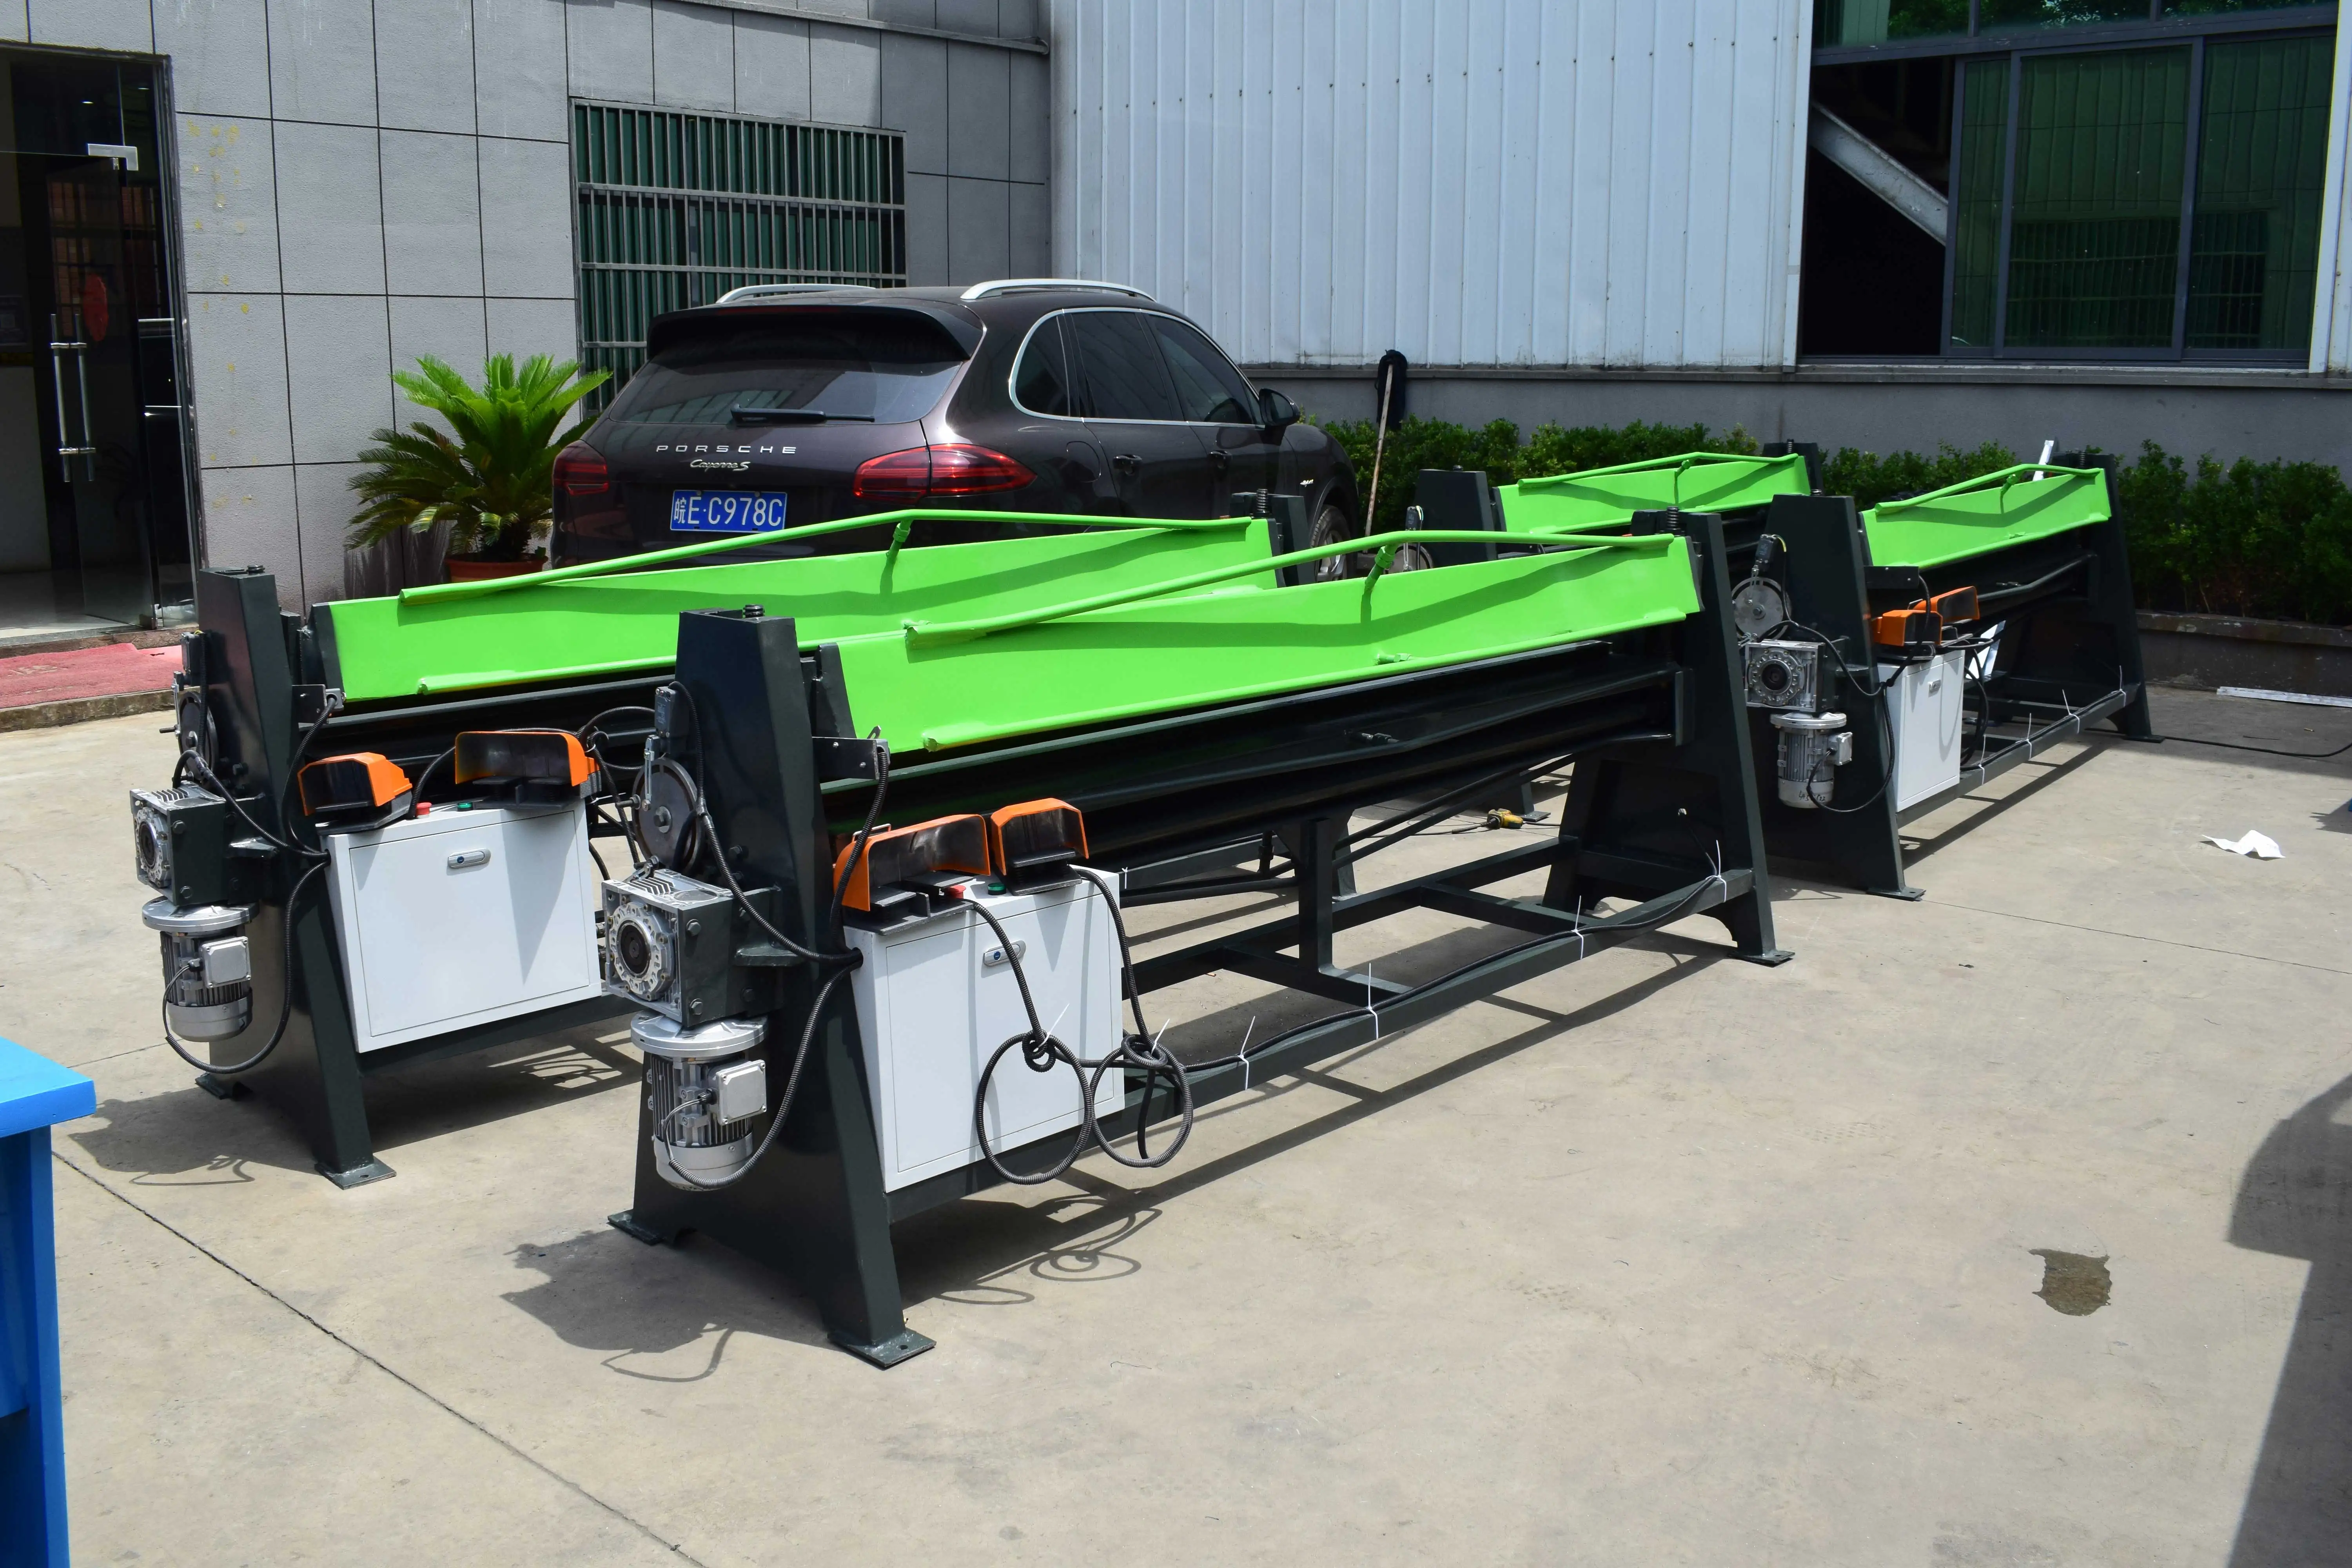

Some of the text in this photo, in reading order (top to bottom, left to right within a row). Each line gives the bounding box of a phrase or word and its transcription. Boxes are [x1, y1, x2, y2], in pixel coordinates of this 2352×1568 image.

[656, 445, 796, 454] PORSCHE
[690, 459, 751, 472] Cayenne S
